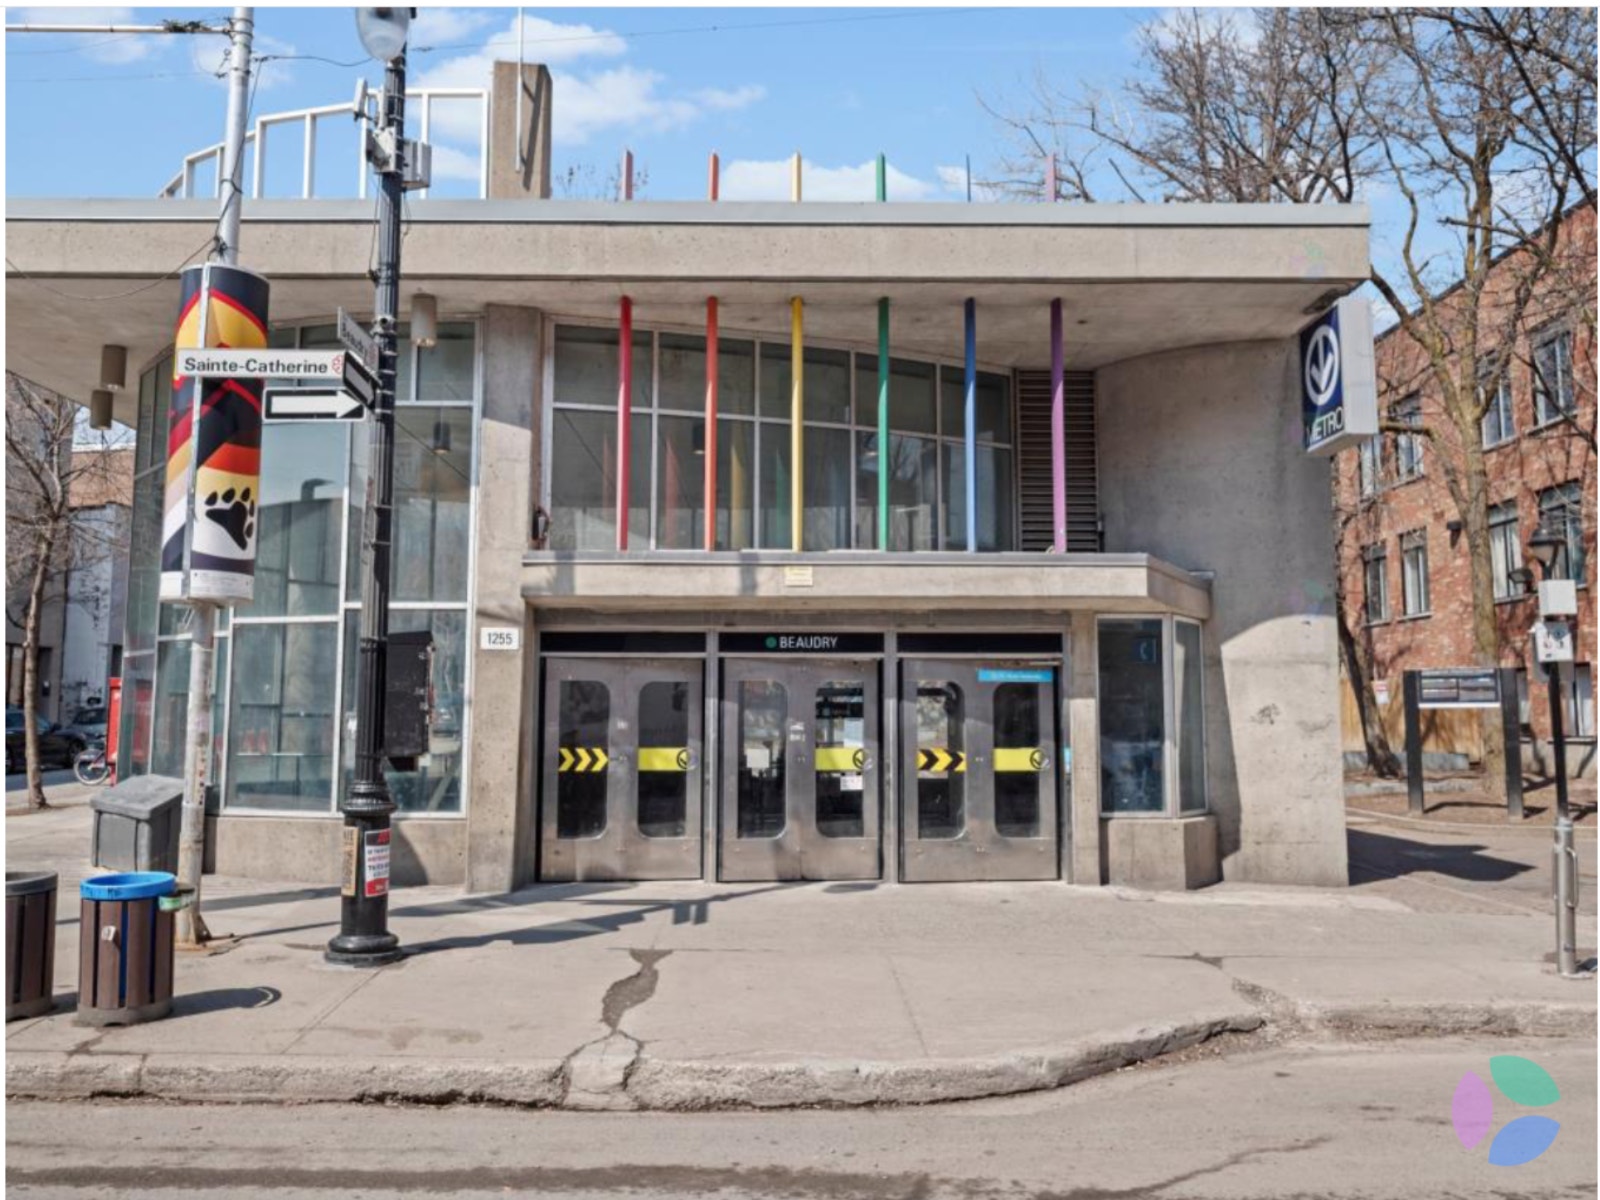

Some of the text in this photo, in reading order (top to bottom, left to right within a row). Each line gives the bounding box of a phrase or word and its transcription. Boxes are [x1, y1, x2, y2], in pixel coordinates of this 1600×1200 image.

[184, 357, 328, 374] Sainte-Catherine
[487, 632, 513, 646] 1255
[779, 635, 838, 649] BEAUDRY
